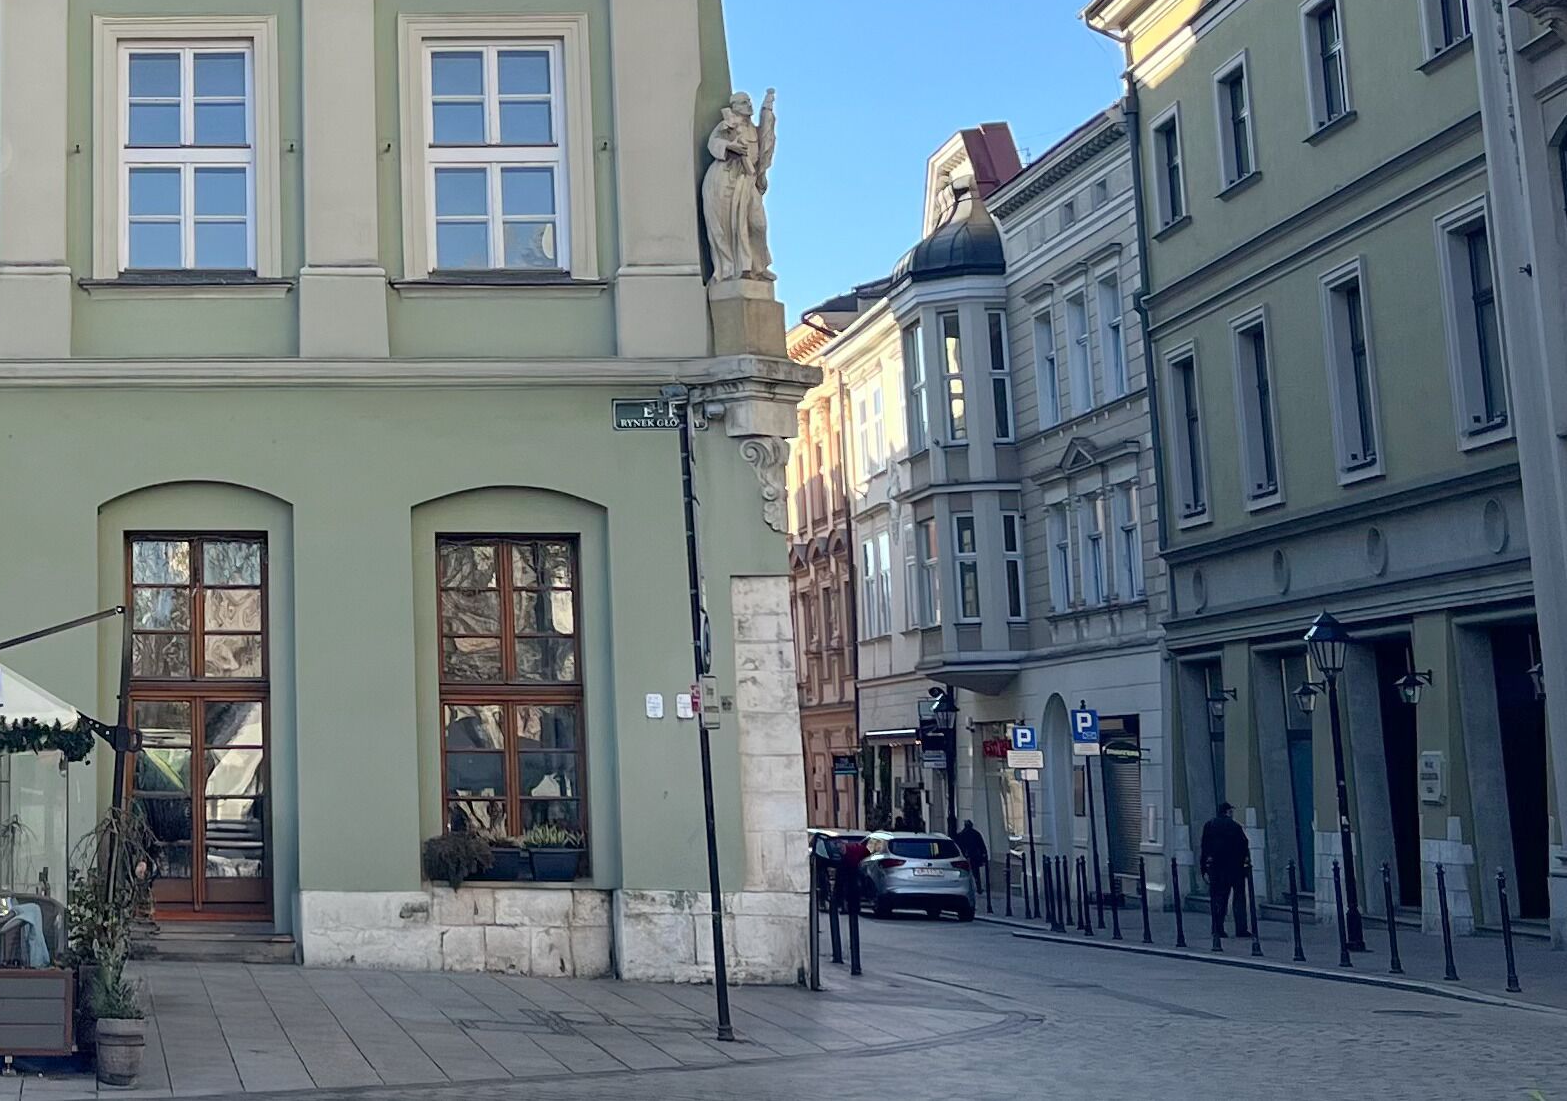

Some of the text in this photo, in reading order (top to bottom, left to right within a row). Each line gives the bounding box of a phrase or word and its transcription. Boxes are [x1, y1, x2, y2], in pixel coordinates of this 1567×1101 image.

[620, 418, 655, 428] RYNEK
[1076, 712, 1092, 733] P
[1016, 728, 1031, 748] P
